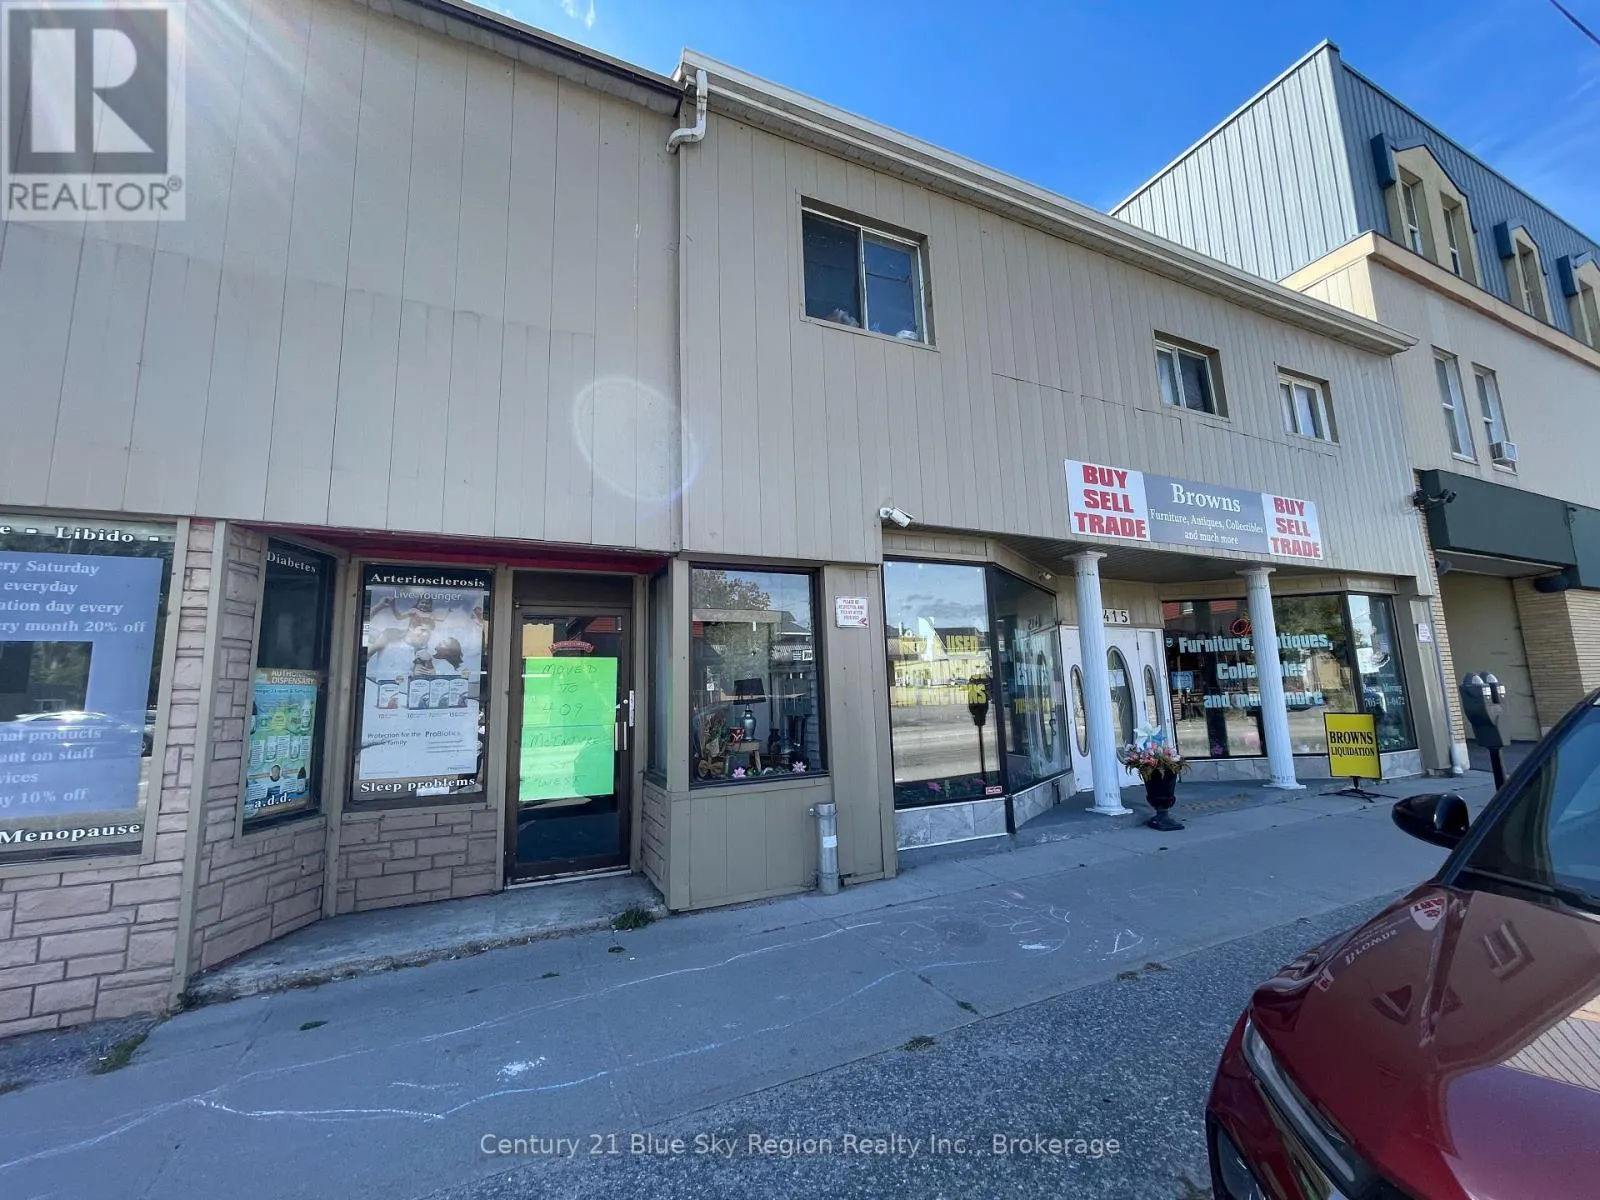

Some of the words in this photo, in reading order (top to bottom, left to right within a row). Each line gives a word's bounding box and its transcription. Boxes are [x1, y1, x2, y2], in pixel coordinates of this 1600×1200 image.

[1082, 465, 1128, 489] BUY
[1083, 488, 1135, 513] SELL
[1170, 483, 1241, 513] Browns
[1273, 497, 1305, 517] BUY
[1074, 512, 1147, 539] TRADE
[1150, 508, 1190, 526] Furniture,
[1191, 514, 1225, 530] Antiques,
[1225, 518, 1264, 534] Collectibles
[1275, 517, 1311, 538] SELL
[56, 526, 134, 542] Libido
[1185, 530, 1198, 541] and
[1200, 531, 1220, 543] much
[1220, 535, 1239, 545] more
[1270, 536, 1321, 558] TRADE
[26, 560, 100, 576] Saturday
[267, 551, 316, 573] Diabetes
[4, 580, 78, 595] everyday
[371, 573, 485, 588] Arteriosclerosis
[394, 590, 415, 600] Live
[46, 600, 75, 615] day
[80, 602, 124, 616] every
[1103, 609, 1129, 623] 415
[25, 620, 79, 632] month
[84, 621, 118, 632] 20%
[123, 621, 149, 633] off
[1178, 634, 1254, 653] Furniture,
[1203, 691, 1231, 708] and
[1232, 690, 1262, 708] mu
[28, 727, 103, 743] products
[1329, 731, 1374, 745] BROWNS
[32, 752, 53, 762] on
[58, 747, 95, 761] staff
[1331, 746, 1375, 758] LIQUIDATION
[360, 782, 402, 793] Sleep
[407, 778, 477, 792] problems
[21, 791, 56, 804] 10%
[63, 788, 89, 801] off
[254, 793, 292, 808] a.d.d.
[0, 823, 141, 844] Menopause
